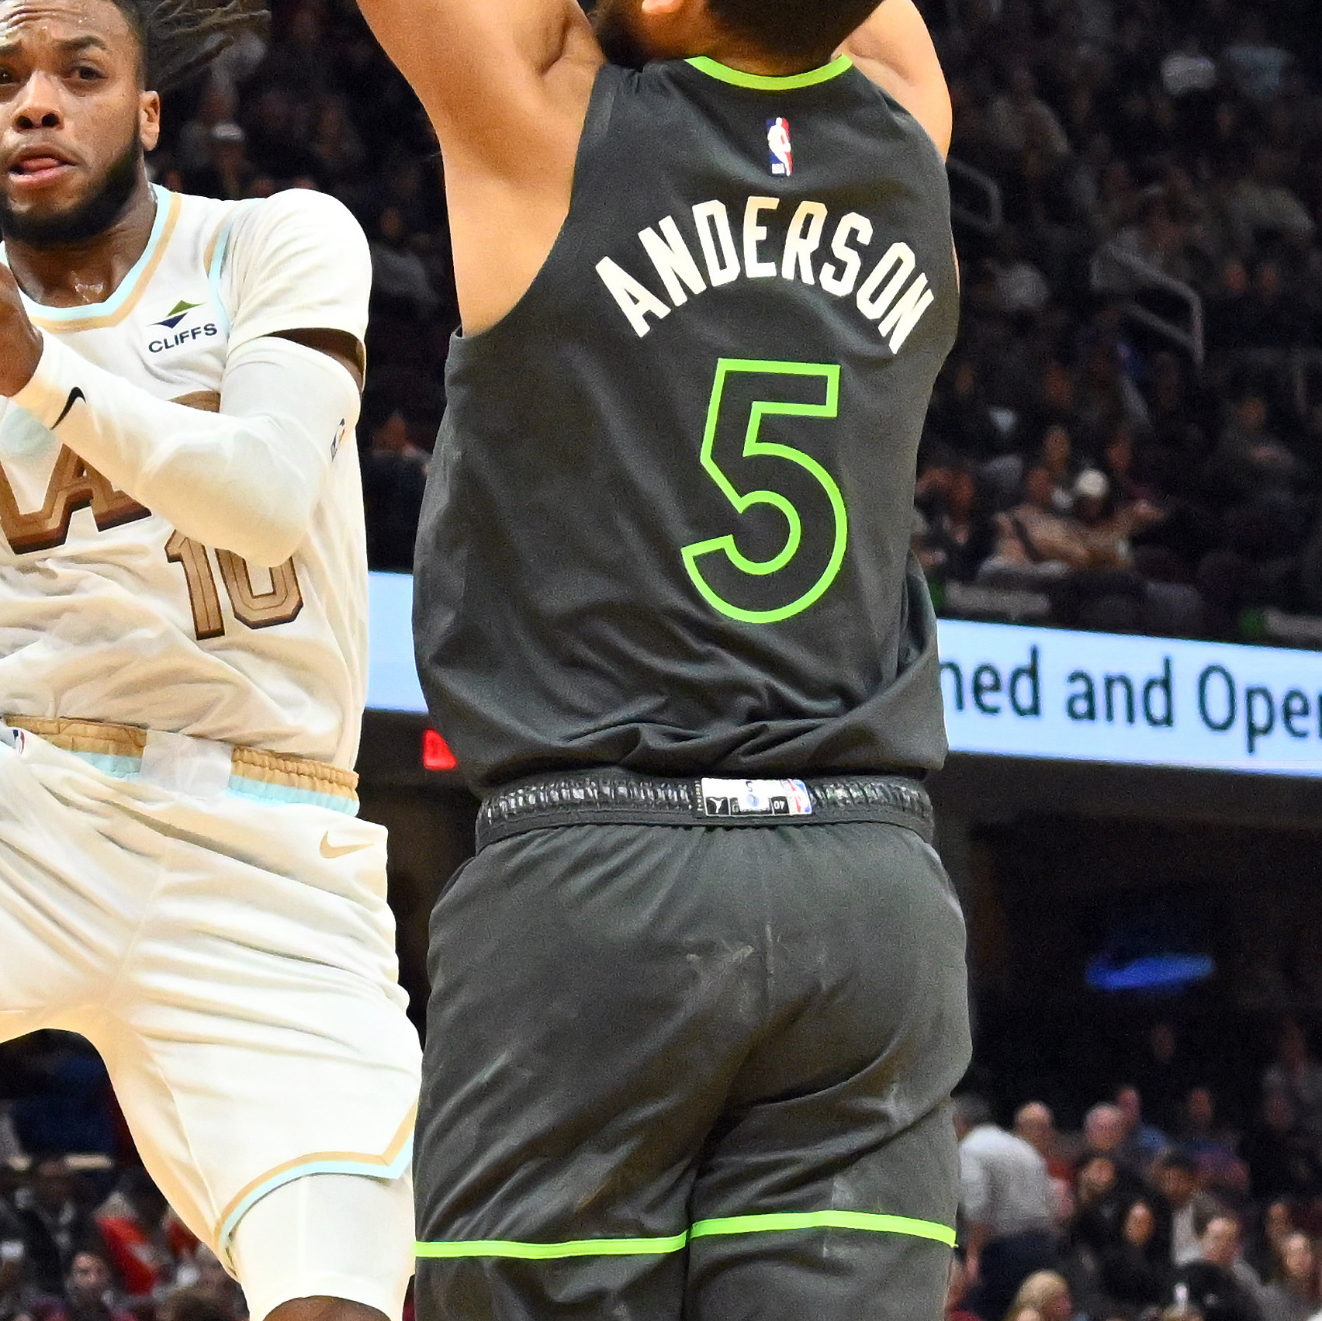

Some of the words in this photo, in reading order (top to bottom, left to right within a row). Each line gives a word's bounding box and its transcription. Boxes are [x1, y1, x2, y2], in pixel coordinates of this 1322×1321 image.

[595, 195, 935, 355] ANDERSON
[148, 321, 218, 354] CLIFFS
[681, 357, 848, 624] 5
[1067, 657, 1174, 728] and
